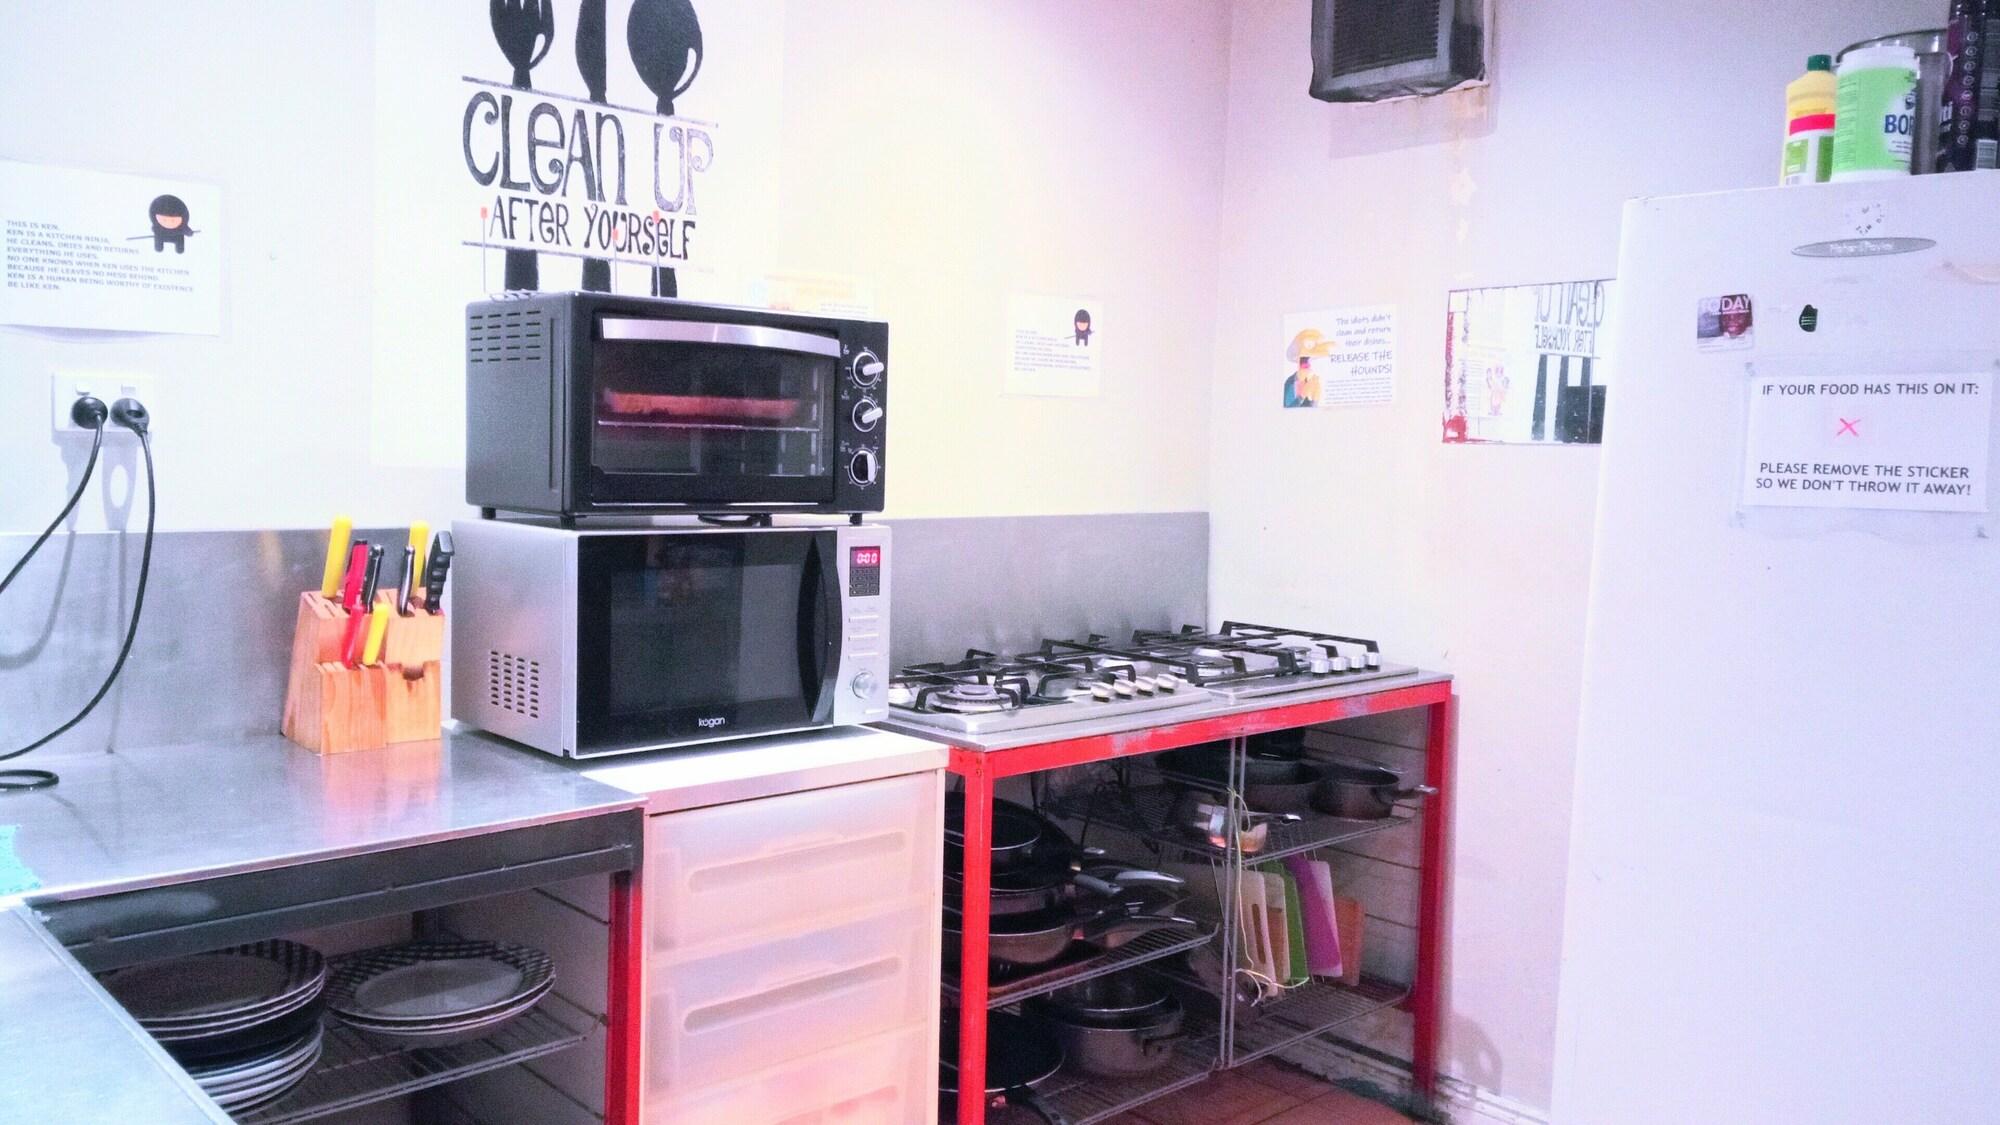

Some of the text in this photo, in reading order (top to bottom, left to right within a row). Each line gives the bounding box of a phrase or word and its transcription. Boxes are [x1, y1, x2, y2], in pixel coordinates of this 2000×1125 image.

[654, 123, 714, 215] UP
[6, 220, 28, 228] THIS
[46, 232, 82, 241] KITCHEN
[7, 246, 61, 257] EVERYTHING
[104, 246, 140, 254] RETURNS
[7, 264, 45, 272] BECAUSE
[106, 279, 139, 288] WORTHY
[1330, 349, 1392, 363] RELEASE THE
[1762, 383, 1980, 396] IF YOUR FOOD HAS THIS ON IT:
[1760, 463, 1970, 478] PLEASE REMOVE THE STICKER
[1756, 478, 1971, 496] SO WE DON'T THROW IT AWAY!
[698, 716, 726, 728] kogan
